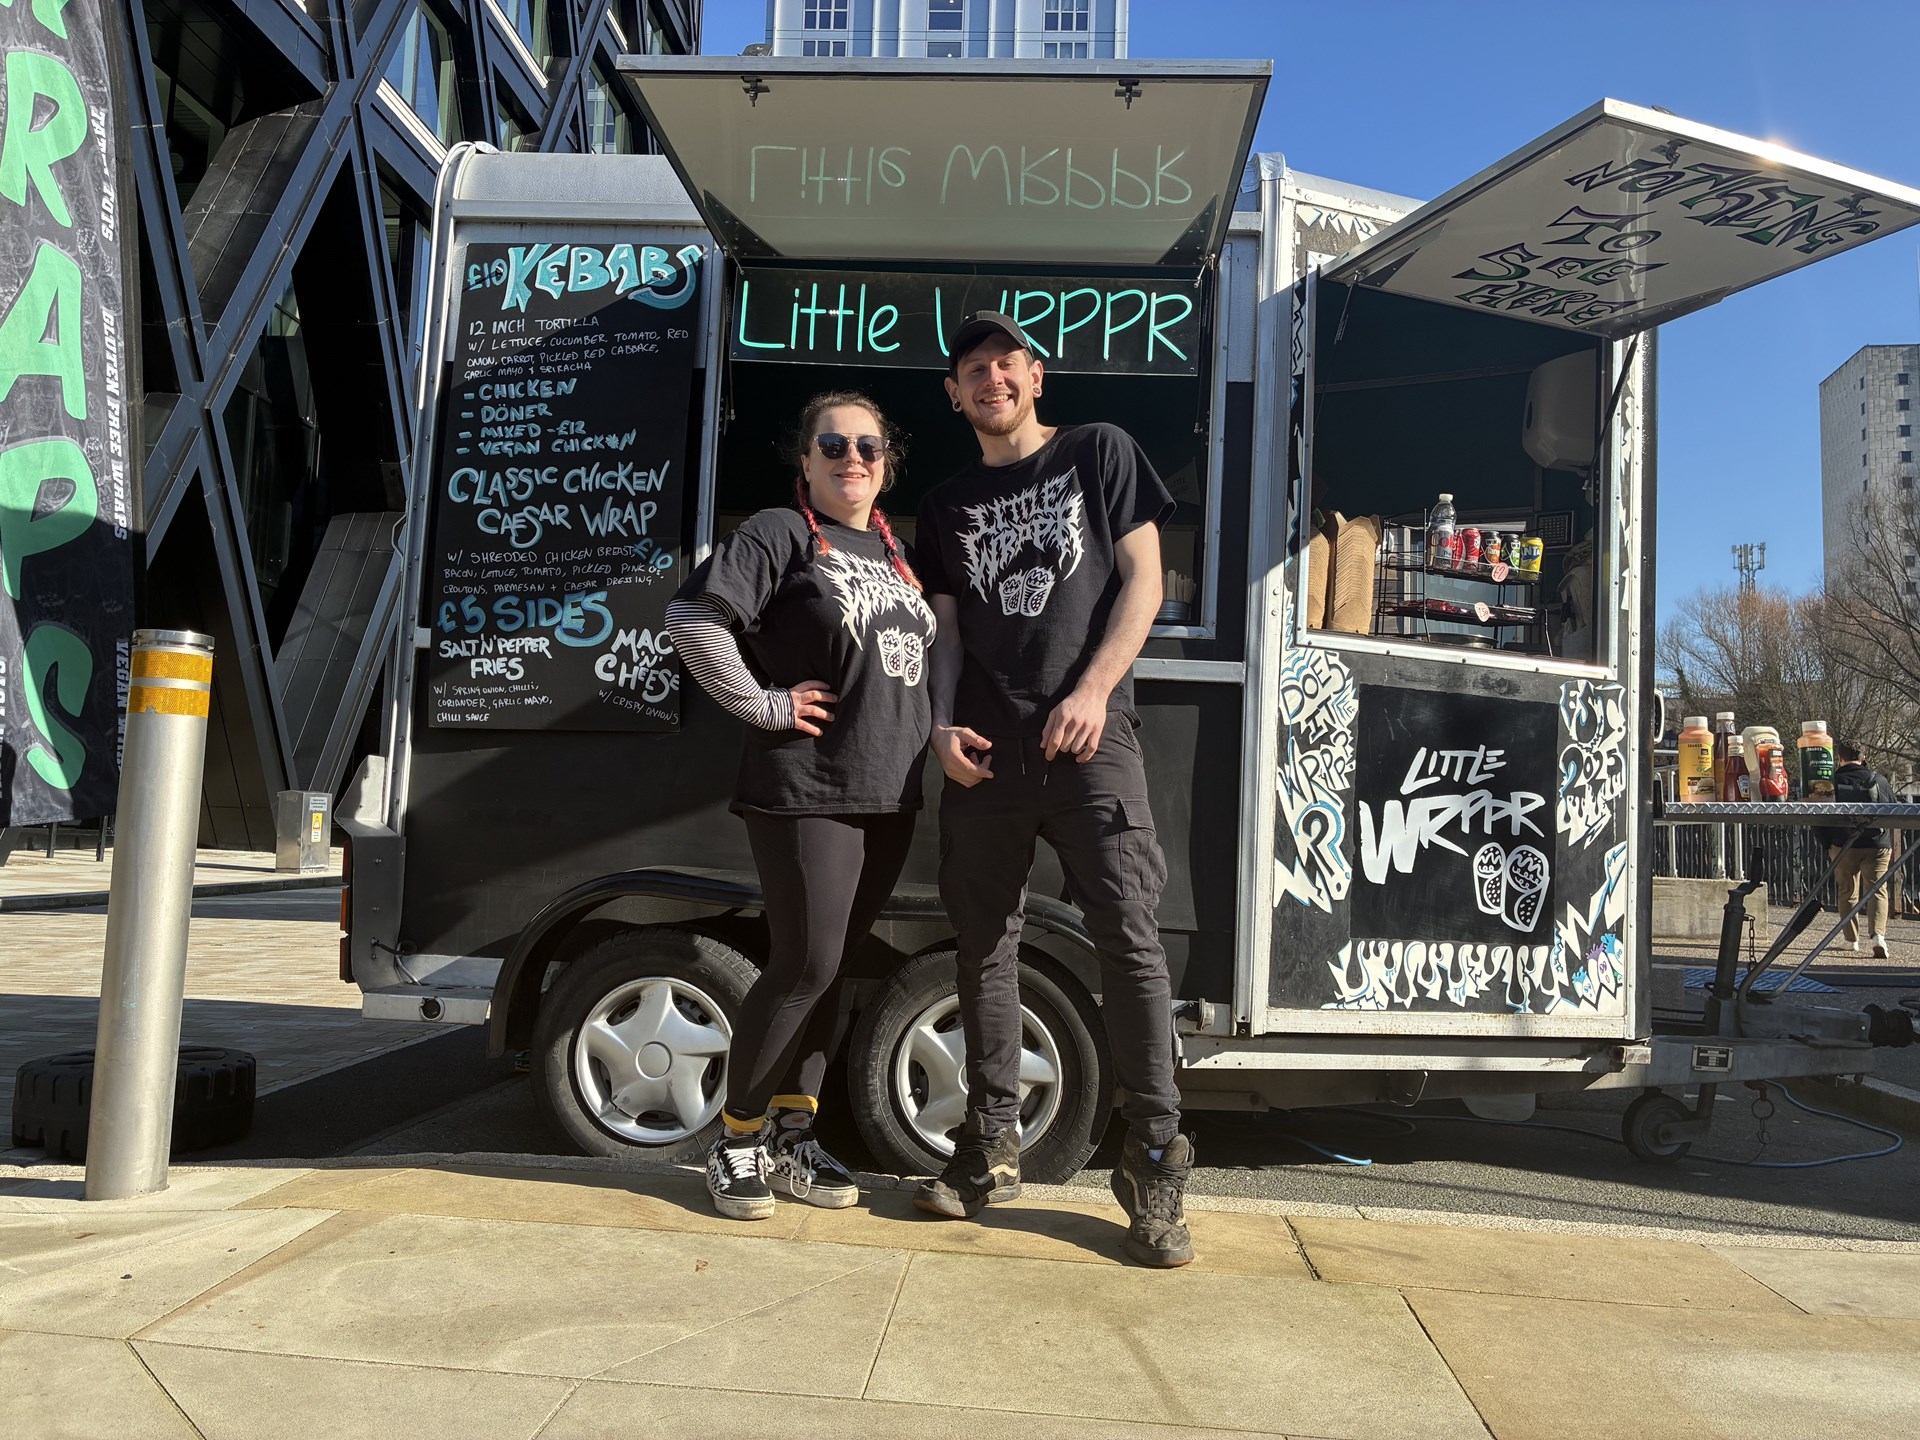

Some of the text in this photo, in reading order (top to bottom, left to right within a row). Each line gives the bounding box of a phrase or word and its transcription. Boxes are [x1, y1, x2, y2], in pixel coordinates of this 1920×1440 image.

[102, 181, 115, 241] TOTS
[1543, 205, 1664, 254] TO
[467, 243, 702, 313] £10 KEBABS
[1452, 242, 1668, 286] SEE
[739, 280, 900, 352] Little
[1454, 281, 1646, 325] HERE
[468, 338, 485, 353] W/
[491, 336, 547, 350] LETTUCE,
[614, 330, 661, 343] TOMATO,
[667, 328, 689, 339] RED
[469, 316, 600, 336] 12 INCH TORTILLA
[464, 368, 493, 381] GARLIC
[498, 366, 523, 377] MAYO
[540, 362, 593, 374] SRIRACHA
[501, 353, 535, 365] CARROT,
[540, 351, 579, 364] PICKLED
[584, 347, 605, 358] RED
[478, 378, 578, 401] CHICKEN
[102, 309, 128, 541] GLUTEN FREE WRAPS
[480, 423, 542, 439] MIXED
[481, 403, 553, 424] DÖNER
[478, 440, 541, 458] VEGAN
[448, 460, 671, 508] CLASSIC CHICKEN
[477, 496, 658, 549] CAESAR WRAP
[443, 568, 478, 579] BACON,
[481, 568, 518, 579] LETTUCE,
[521, 566, 567, 578] TOMATO,
[572, 564, 612, 576] PICKLED
[621, 562, 646, 574] PINK
[447, 549, 463, 565] W/
[471, 551, 538, 564] SHREDDED
[545, 547, 593, 564] CHICKEN
[443, 584, 488, 595] CROUTONS,
[494, 583, 545, 593] PARMESAN
[550, 583, 557, 592] +
[564, 579, 597, 592] CAESAR
[437, 590, 614, 647] £5 SIDES
[610, 628, 674, 663] MAC
[116, 641, 129, 708] VEGAN
[470, 657, 525, 681] FRIES
[594, 653, 680, 703] CHEESE
[433, 682, 447, 698] W/
[452, 686, 480, 696] SPRING
[492, 698, 522, 709] GARLIC
[524, 695, 553, 705] MAYO,
[598, 689, 679, 725] W/ CRISPY ONIONS
[436, 713, 490, 723] CHILLI SAUCE
[1400, 744, 1507, 795] LITTLE
[1359, 789, 1545, 885] WRPPR
